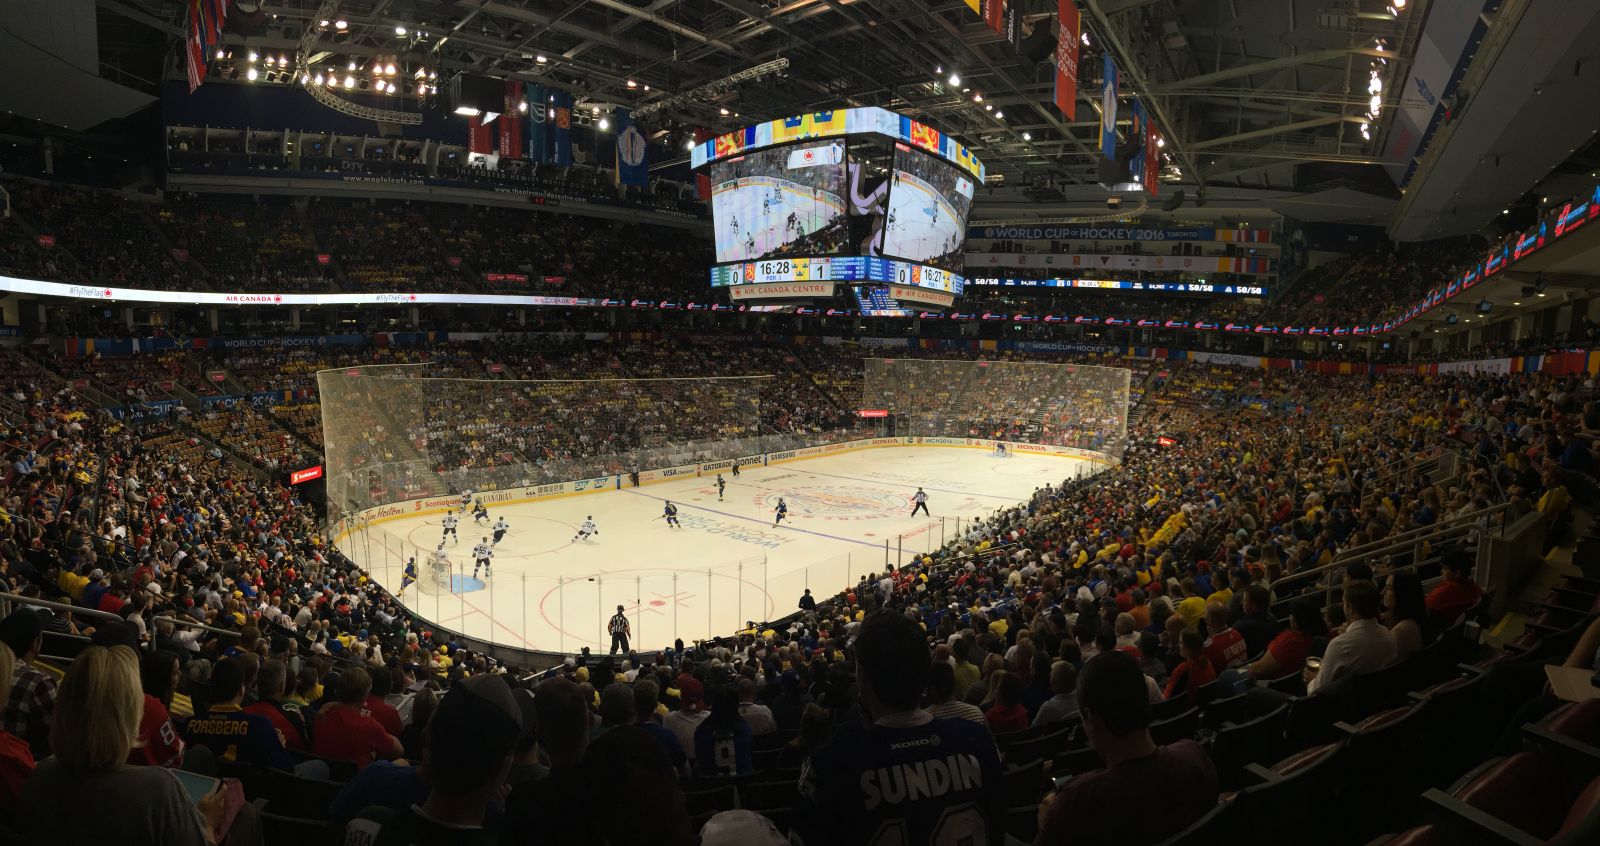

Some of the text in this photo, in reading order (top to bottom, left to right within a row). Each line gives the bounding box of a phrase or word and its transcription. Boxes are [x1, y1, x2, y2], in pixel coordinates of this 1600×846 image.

[343, 176, 424, 185] www.mapleleafs.com
[996, 229, 1043, 239] WORLD
[1044, 229, 1069, 239] CUP
[1079, 229, 1134, 239] HOCKEY
[1136, 229, 1165, 240] 2016
[760, 261, 790, 276] 16:28
[817, 265, 823, 279] 1
[732, 271, 739, 284] 0
[899, 269, 906, 283] 0
[924, 268, 942, 282] 16:27
[69, 287, 104, 298] #FlyTheFlag
[758, 286, 789, 294] CANADA
[792, 285, 826, 293] CENTRE
[1188, 284, 1214, 292] 50/50
[1236, 286, 1262, 294] 50/50
[224, 339, 257, 348] WORLD
[257, 338, 275, 347] CUP
[281, 337, 315, 347] HOCKEY
[1076, 345, 1106, 353] HOCKEY
[738, 456, 762, 466] onnet
[770, 452, 796, 461] SAMSUNG
[662, 469, 677, 477] VISA
[483, 493, 513, 503] CANADIAN
[376, 506, 405, 519] Hortons
[186, 719, 249, 736] FORSBERG
[714, 739, 737, 776] 9
[860, 753, 984, 810] SUNDIN
